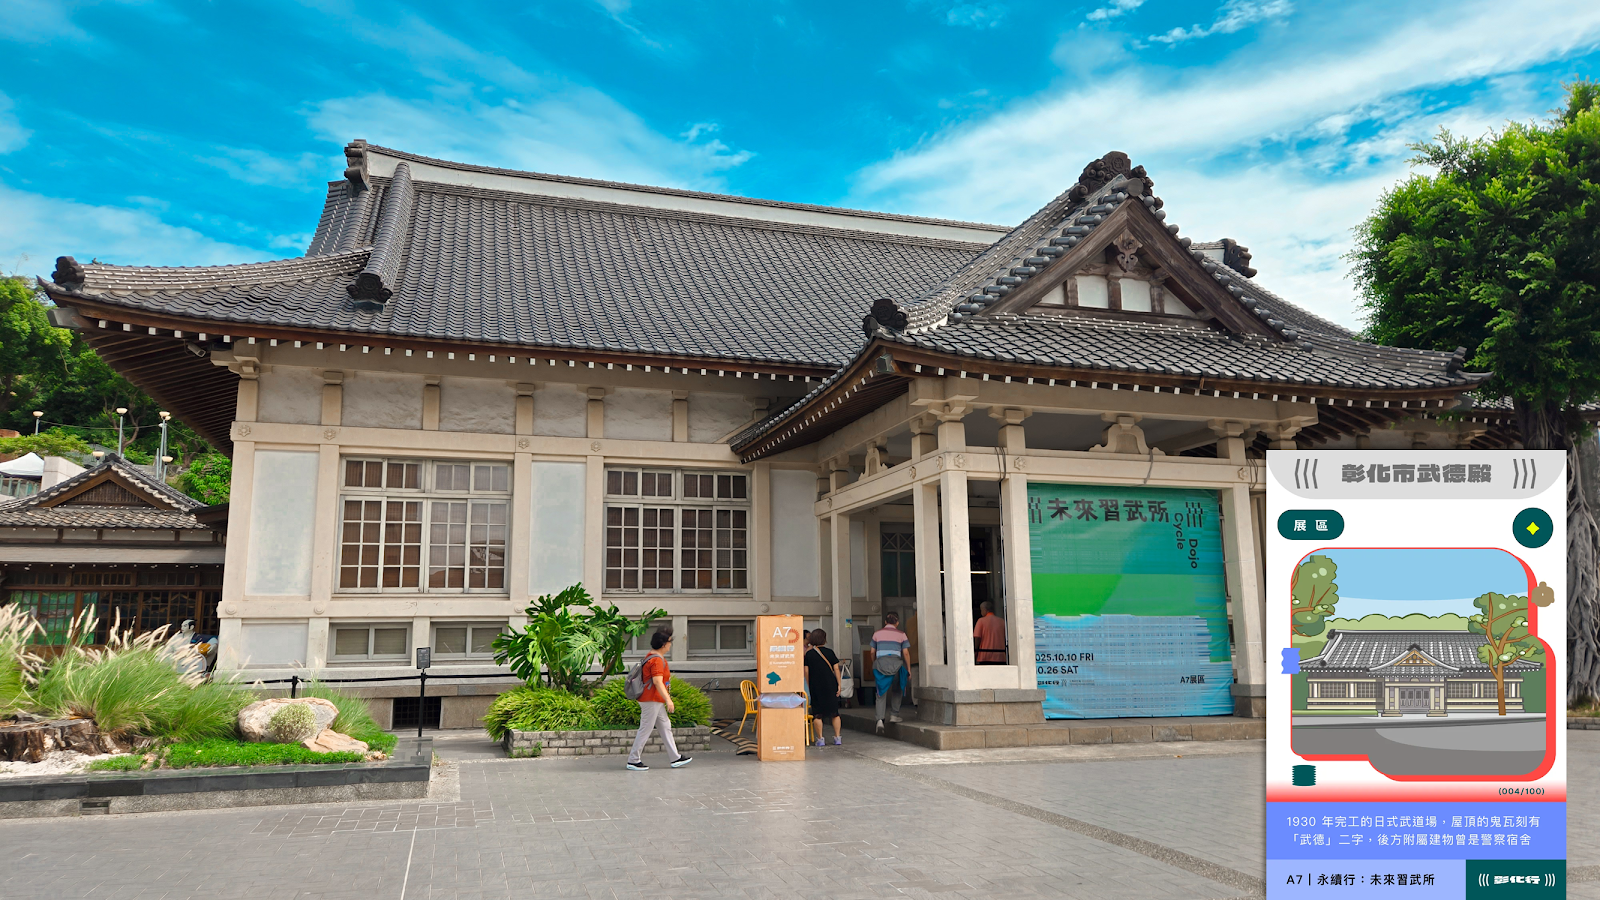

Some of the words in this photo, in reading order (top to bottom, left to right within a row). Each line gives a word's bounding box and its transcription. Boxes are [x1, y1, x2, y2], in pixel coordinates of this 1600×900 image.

[1047, 498, 1169, 522] 未來習武所
[1173, 512, 1186, 550] Cycle
[1187, 538, 1200, 569] Dojo
[772, 626, 792, 638] A7
[1079, 652, 1094, 661] FRI
[1060, 665, 1079, 674] SAT
